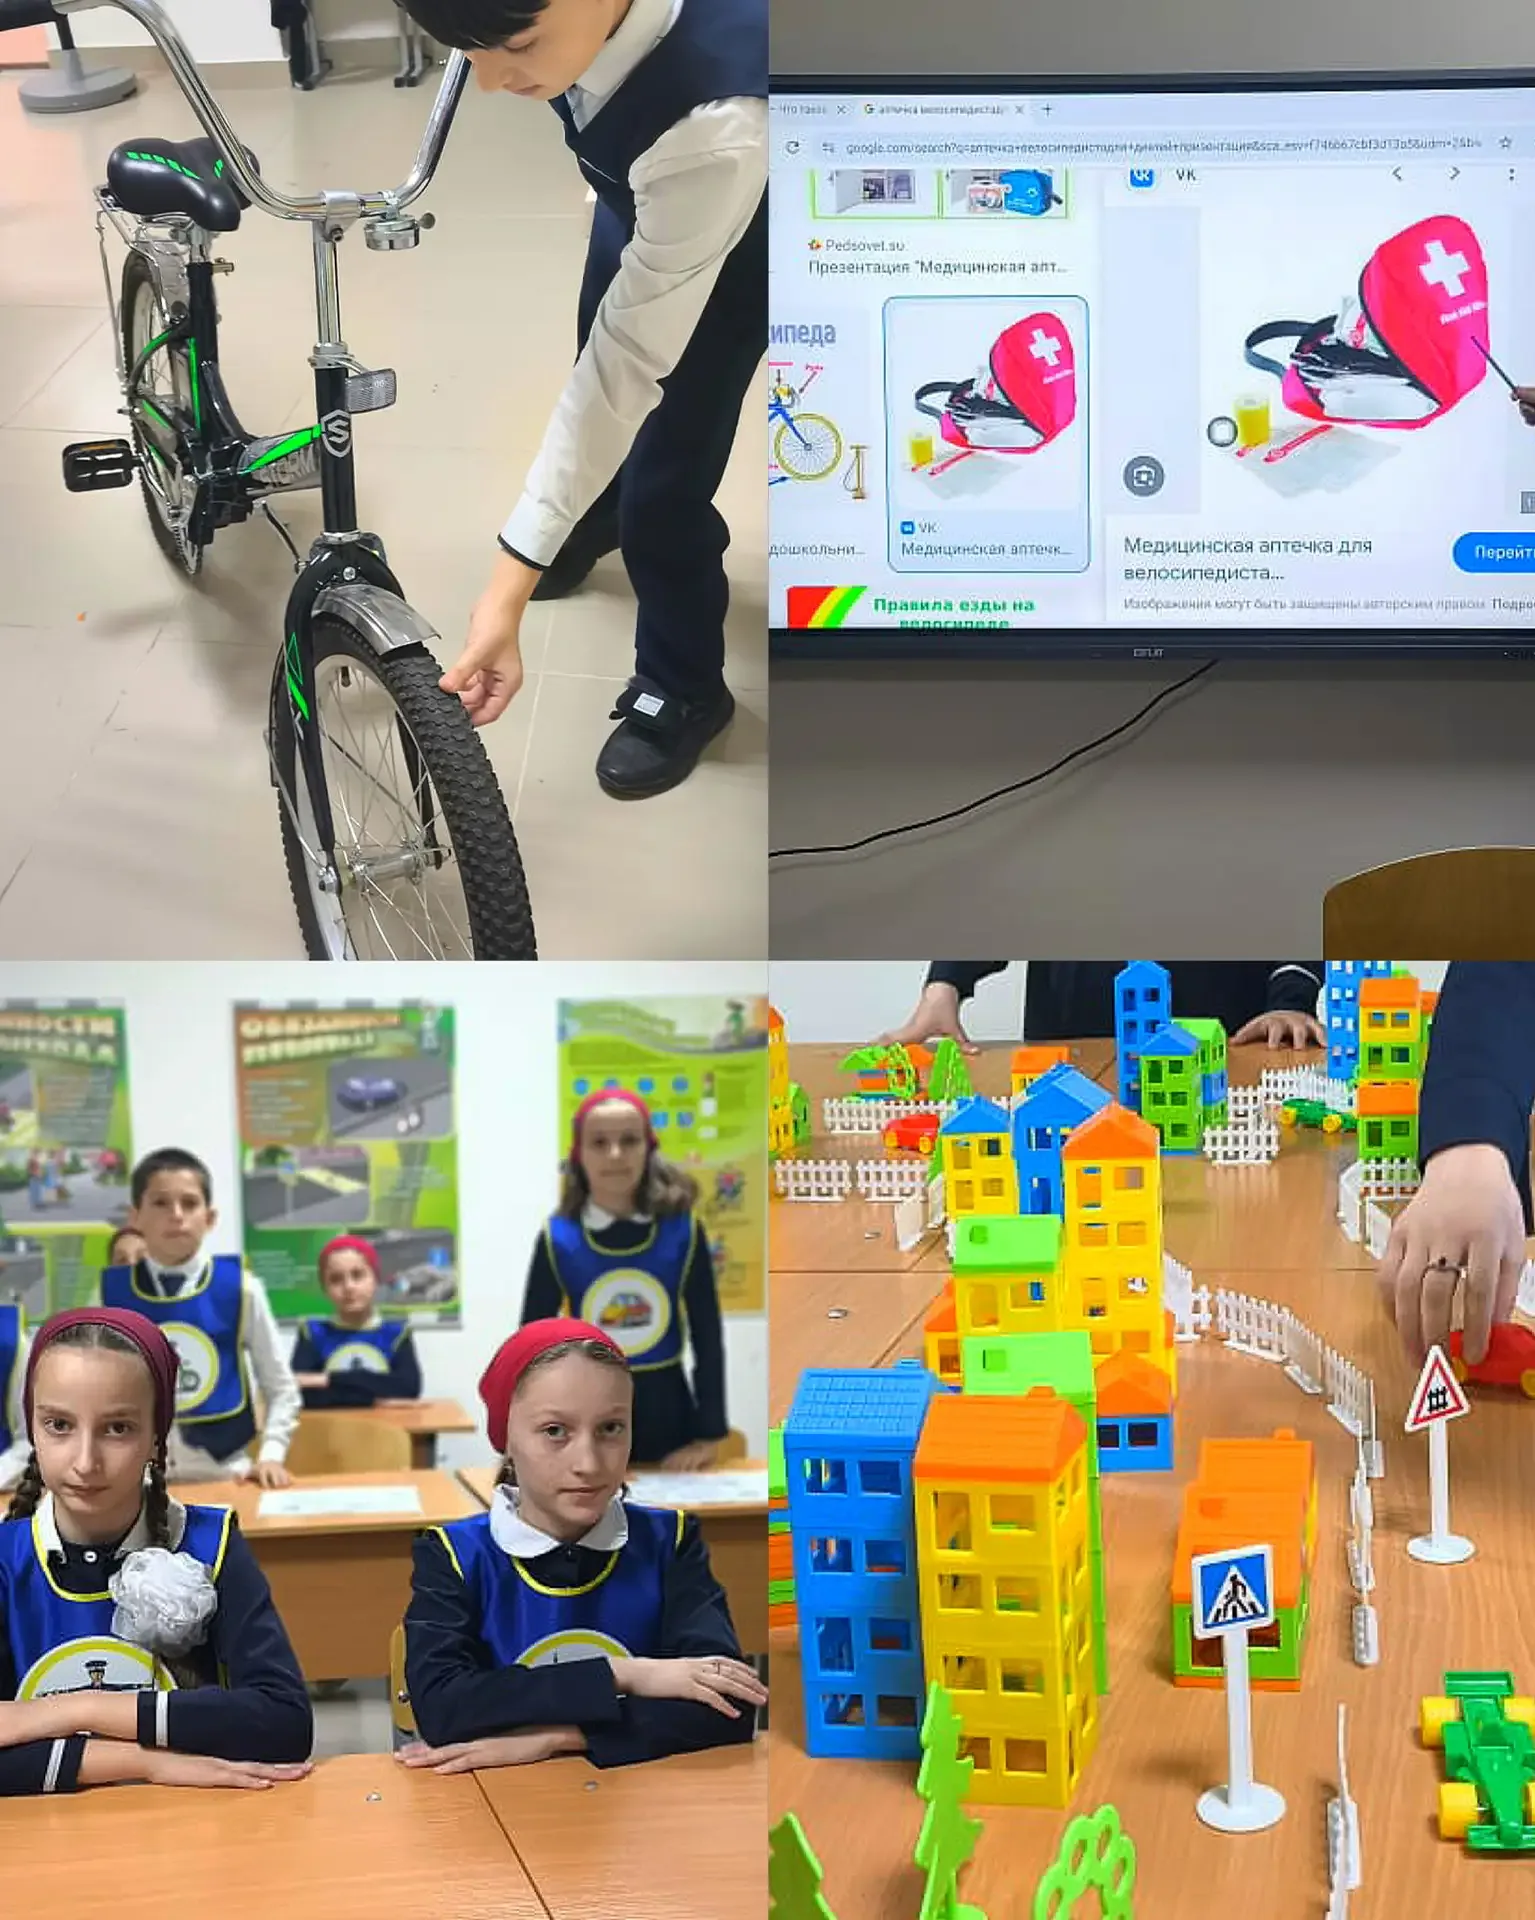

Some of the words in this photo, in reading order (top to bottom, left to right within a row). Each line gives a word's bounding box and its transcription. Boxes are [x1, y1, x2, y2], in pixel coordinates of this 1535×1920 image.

[1175, 168, 1196, 182] VK
[825, 238, 905, 252] Pedsovet.su
[808, 259, 910, 277] Презентация
[901, 542, 1005, 559] Медицинская
[1124, 537, 1254, 557] Медицинская
[1259, 540, 1333, 554] аптечка
[1337, 540, 1373, 556] для
[872, 598, 954, 614] Правила
[959, 599, 1007, 614] езды
[1012, 599, 1036, 612] на
[1123, 597, 1211, 613] Изображения
[1214, 599, 1252, 612] могут
[1254, 597, 1287, 610] быть
